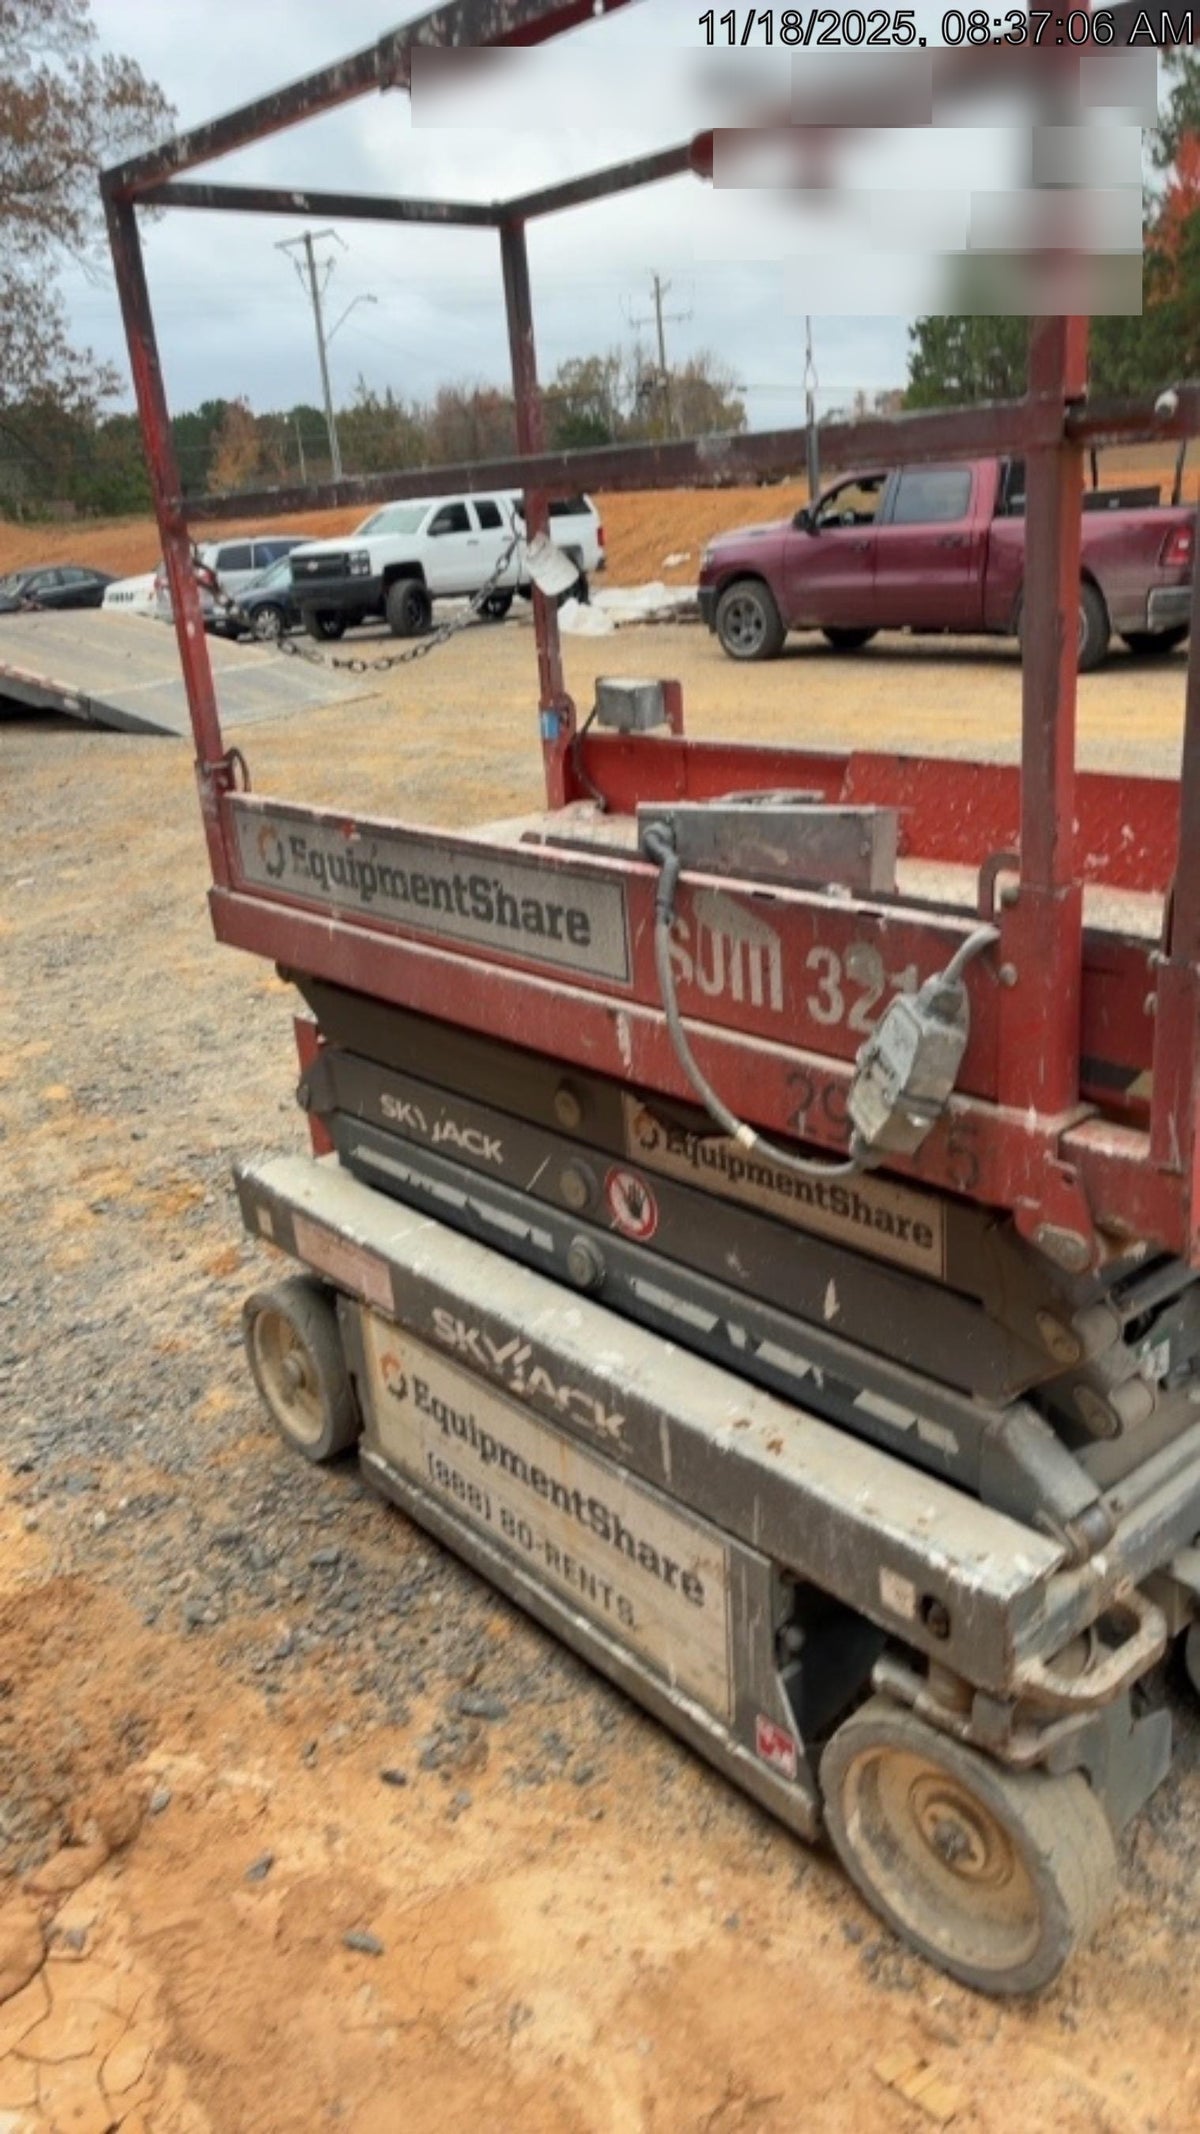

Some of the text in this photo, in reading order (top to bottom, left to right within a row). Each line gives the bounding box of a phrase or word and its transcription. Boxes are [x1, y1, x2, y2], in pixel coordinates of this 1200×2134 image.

[288, 837, 591, 947] EquipmentShare
[664, 1124, 933, 1249] EquipmentShare
[412, 1375, 706, 1606] EquipmentShare
